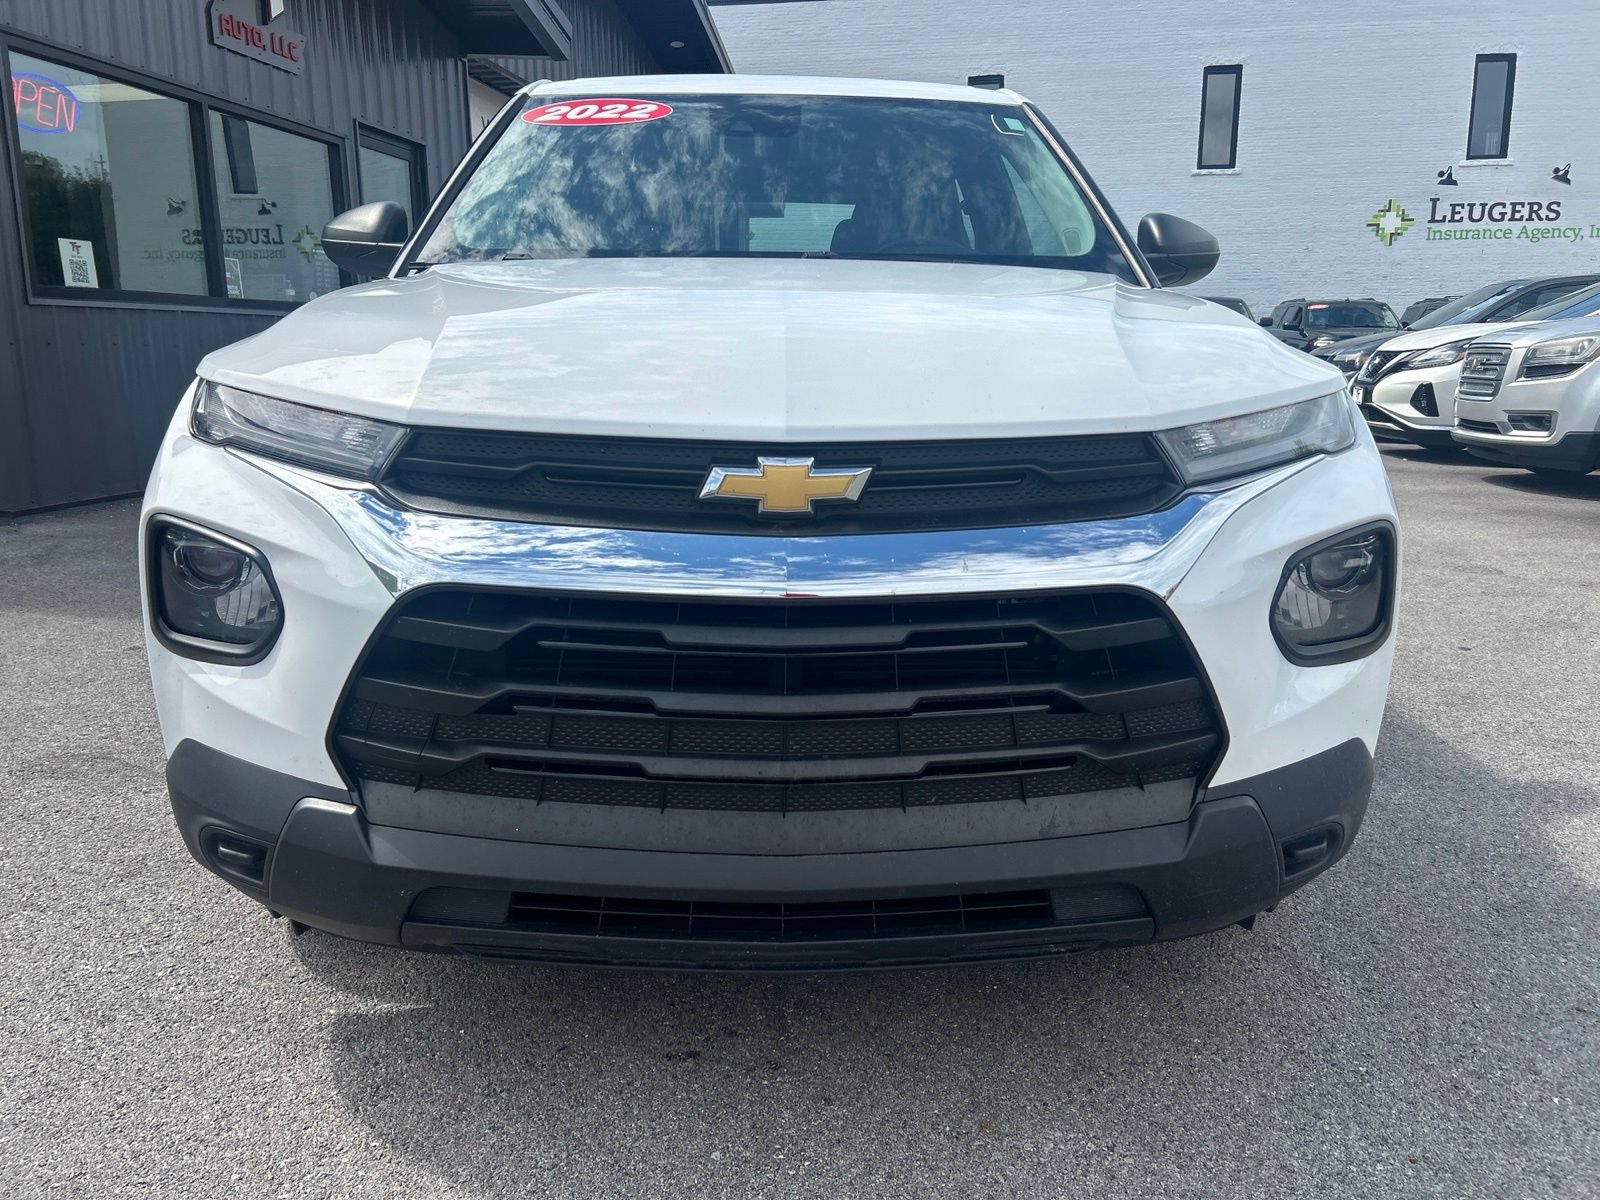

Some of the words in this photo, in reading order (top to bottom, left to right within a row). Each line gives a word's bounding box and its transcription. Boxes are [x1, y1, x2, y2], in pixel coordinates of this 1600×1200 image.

[270, 32, 299, 62] LLC
[534, 103, 658, 121] 2022
[1427, 198, 1561, 223] LEUGERS
[1426, 226, 1513, 241] Insurance
[1516, 225, 1584, 243] Agency,
